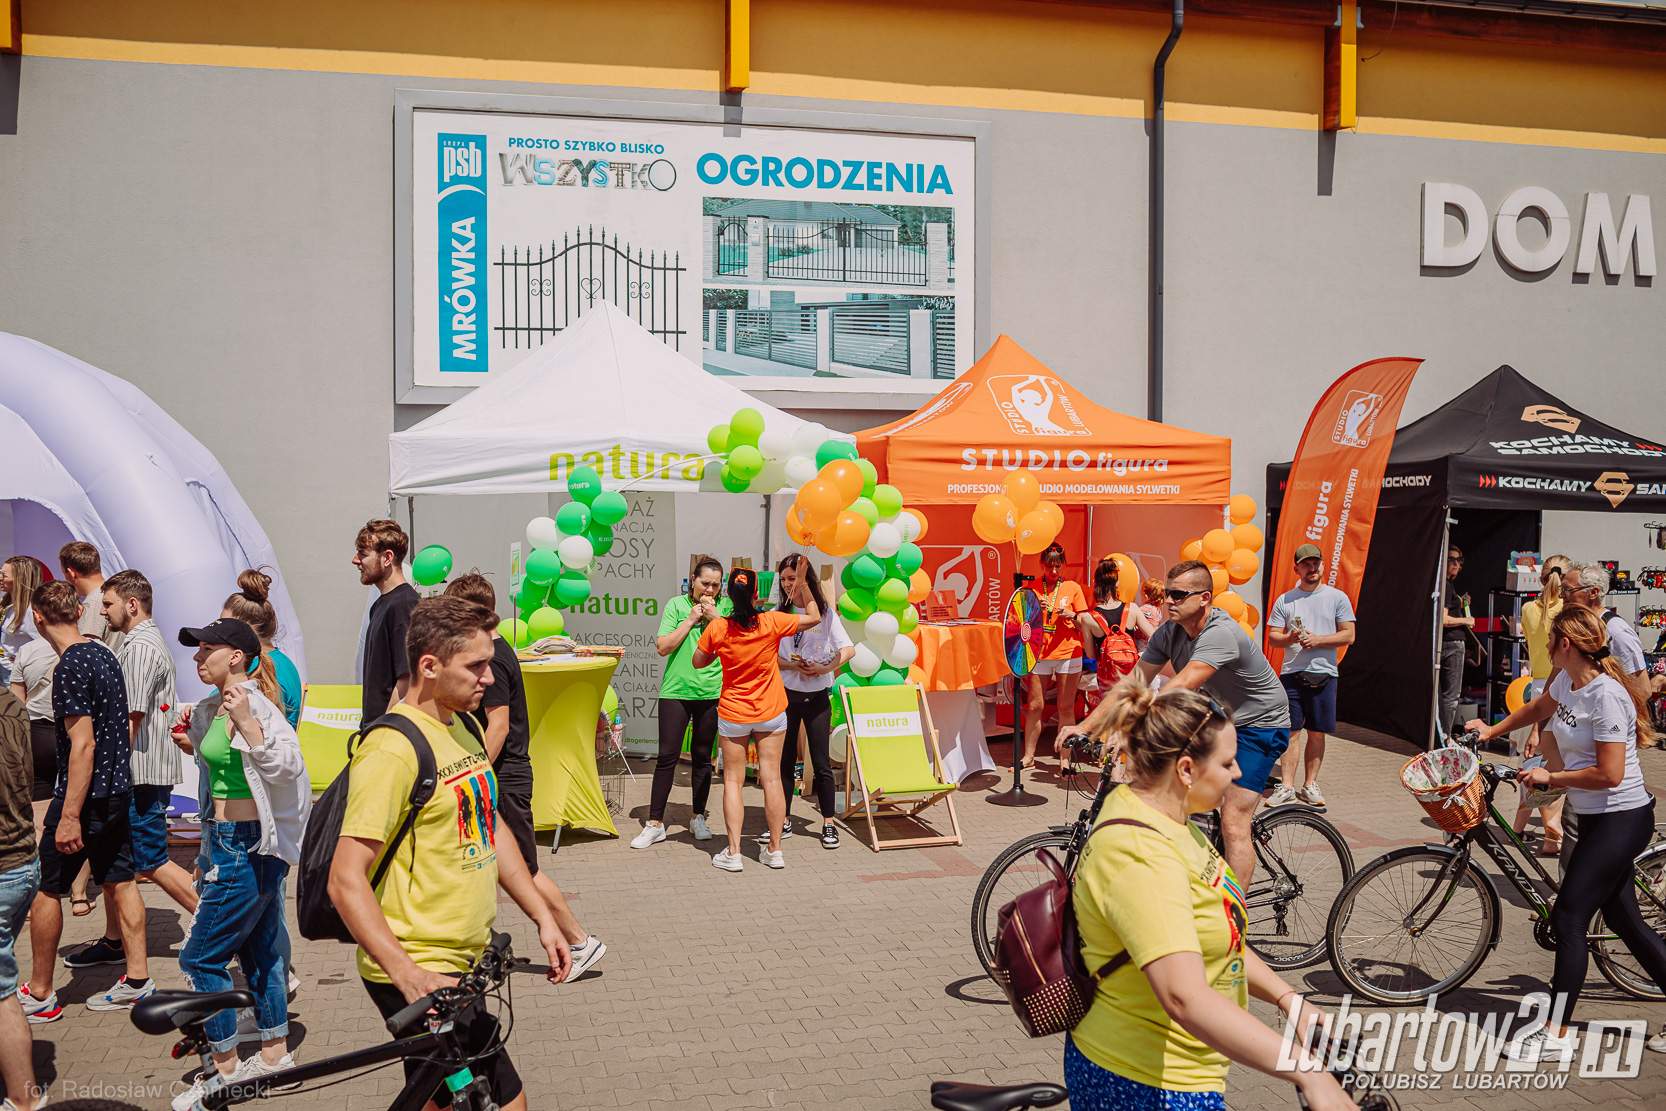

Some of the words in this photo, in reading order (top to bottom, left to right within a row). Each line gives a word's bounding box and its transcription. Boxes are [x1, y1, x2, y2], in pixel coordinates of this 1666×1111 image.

[508, 137, 560, 150] PROSTO
[564, 140, 616, 153] SZYBKO
[620, 142, 665, 155] BLISKO
[443, 141, 482, 183] psb
[498, 152, 677, 192] WSZYSTKO
[696, 152, 954, 195] OGRODZENIA
[1420, 182, 1657, 276] DOM
[443, 216, 477, 361] MRÓWKA
[1488, 434, 1631, 449] KOCHAMY
[549, 443, 705, 481] natura
[960, 447, 1091, 472] STUDIO
[1096, 451, 1169, 477] figura
[947, 484, 1004, 495] PROFESJON
[1039, 484, 1063, 494] UDIO
[1065, 484, 1135, 495] MODELOWANIA
[1136, 485, 1181, 495] SYLWETKI
[1498, 476, 1593, 492] KOCHAMY
[1305, 480, 1333, 542] figura
[608, 537, 655, 559] OSY
[570, 592, 658, 616] natura
[986, 577, 1001, 622] ARTÓW
[575, 632, 657, 648] AKCESORIA
[623, 681, 659, 693] CIAŁA
[866, 716, 910, 729] natura
